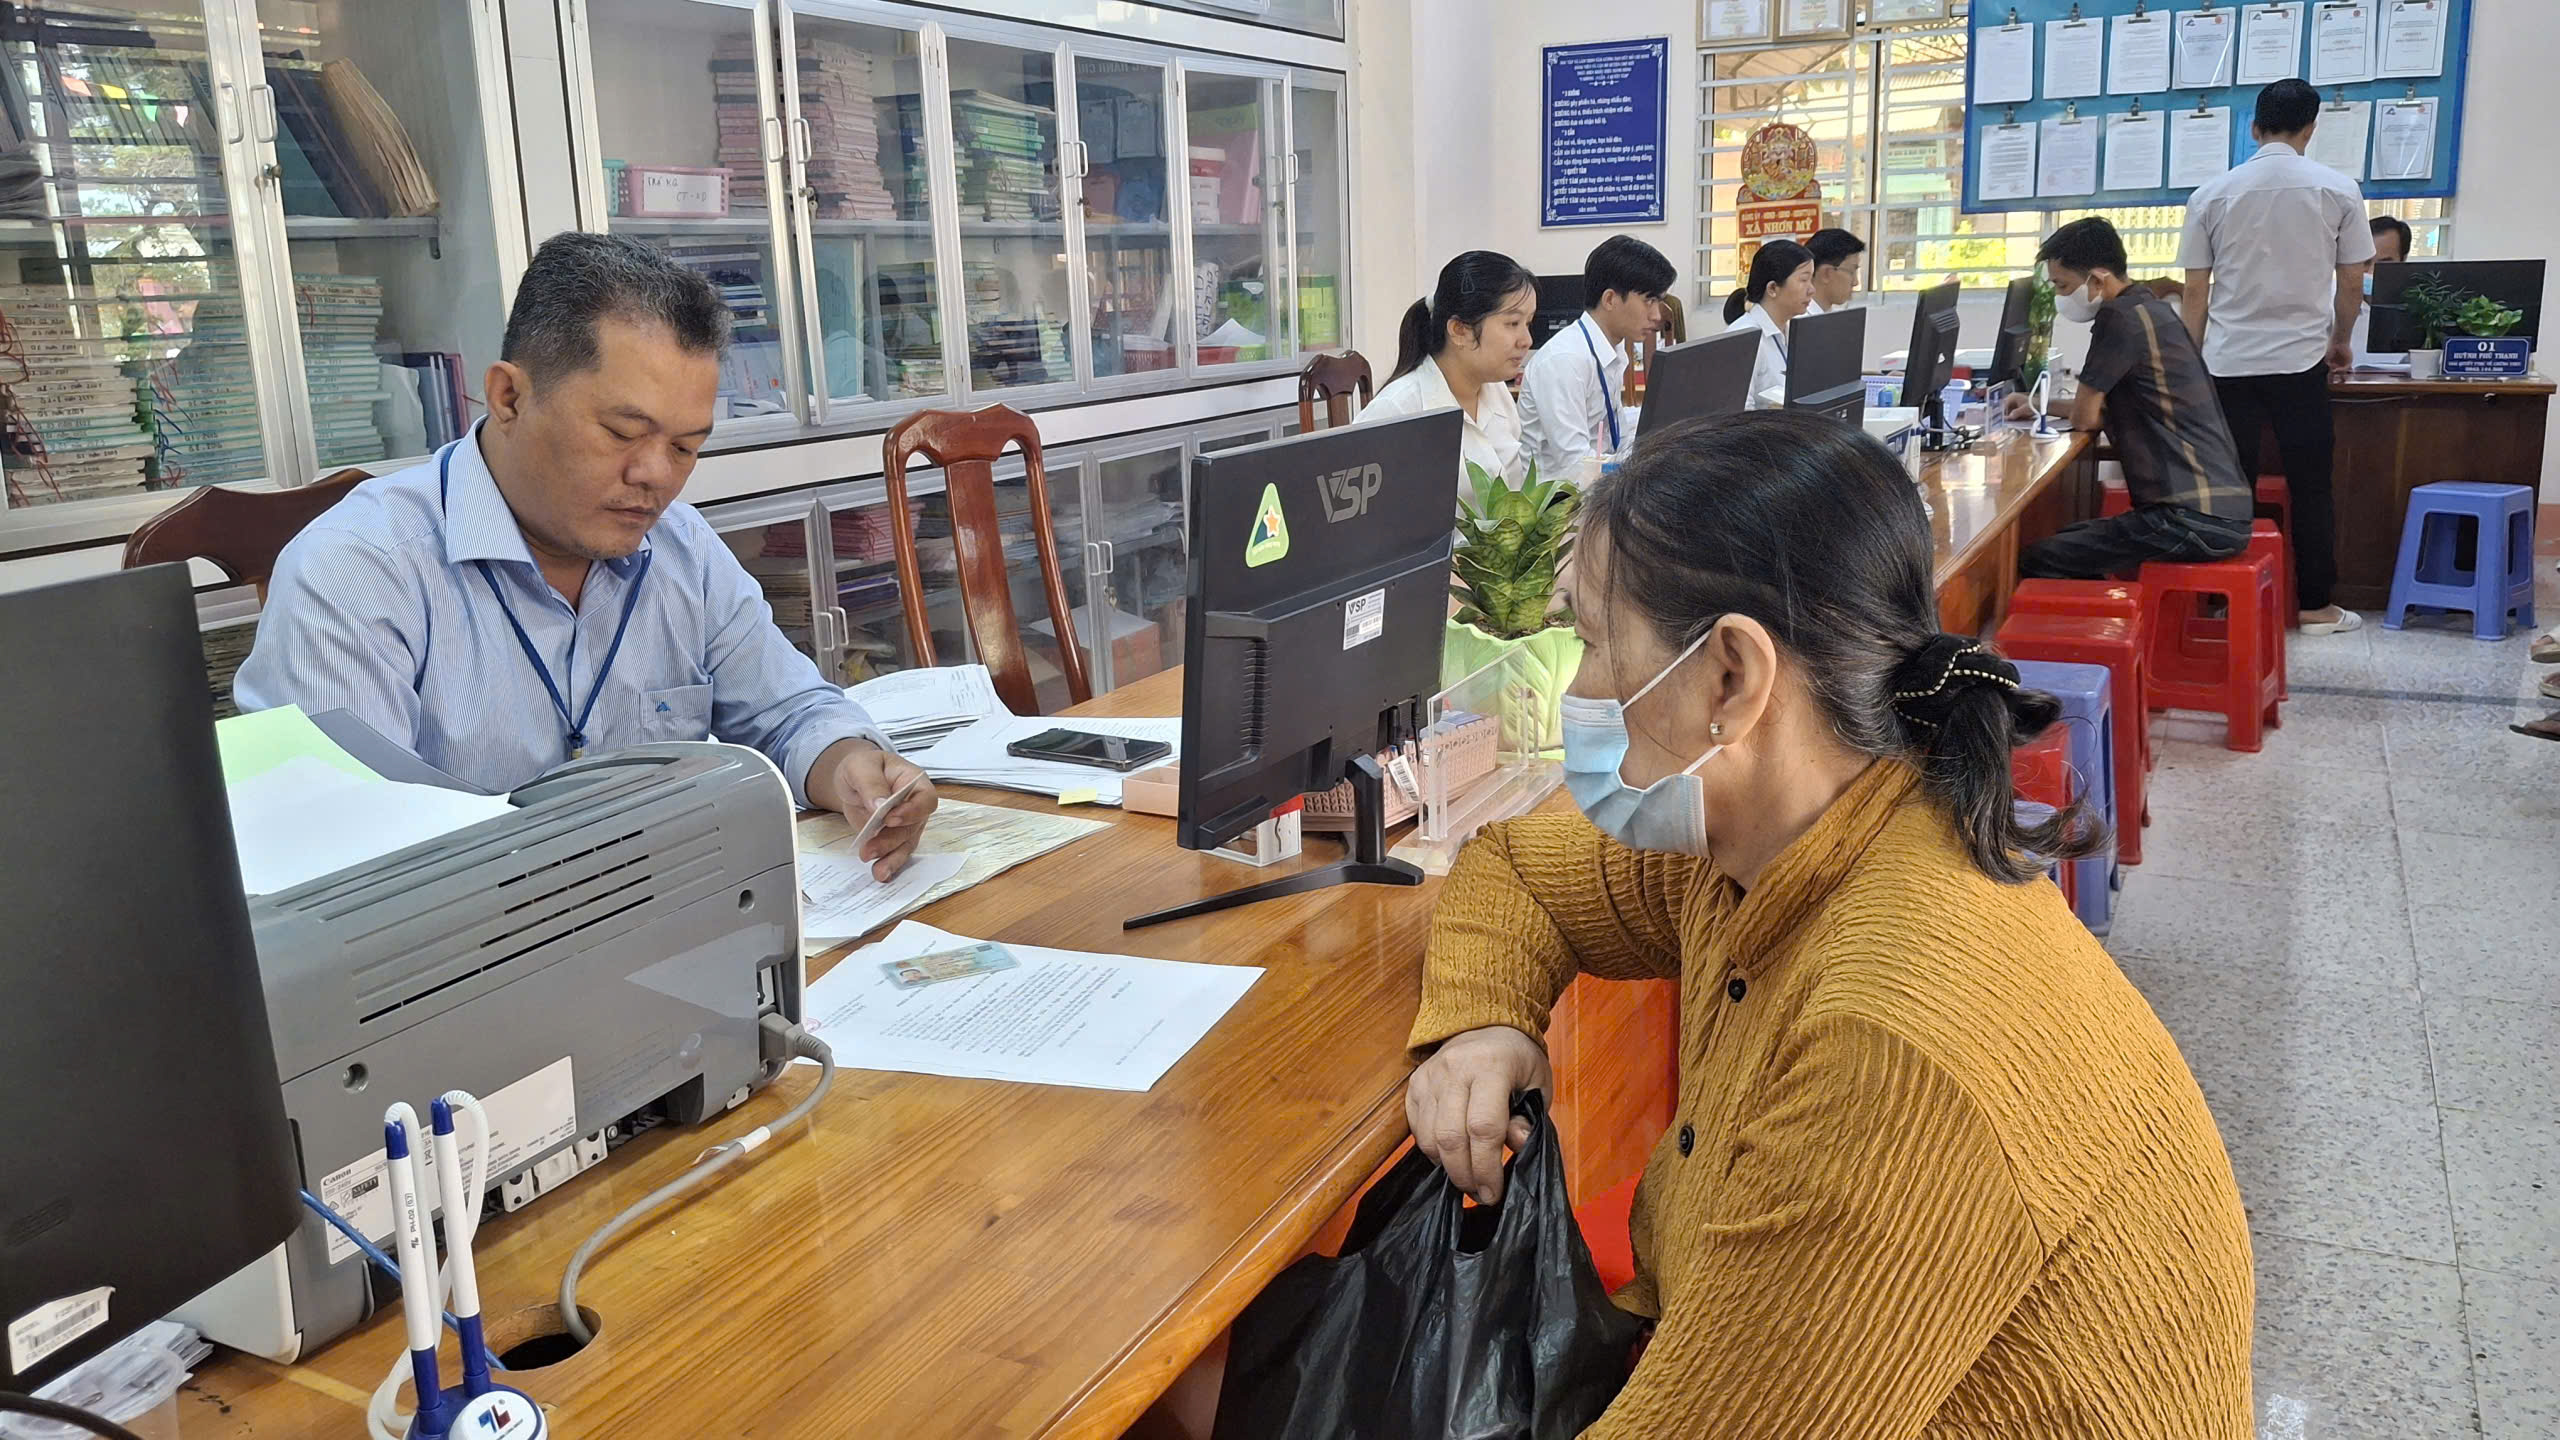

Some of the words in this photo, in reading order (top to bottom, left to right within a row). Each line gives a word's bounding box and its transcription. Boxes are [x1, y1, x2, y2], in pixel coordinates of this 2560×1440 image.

[1746, 220, 1761, 235] XÃ
[2478, 342, 2496, 351] 01
[1316, 463, 1382, 523] VSP
[1348, 598, 1366, 615] VSP
[323, 1169, 352, 1186] Canon
